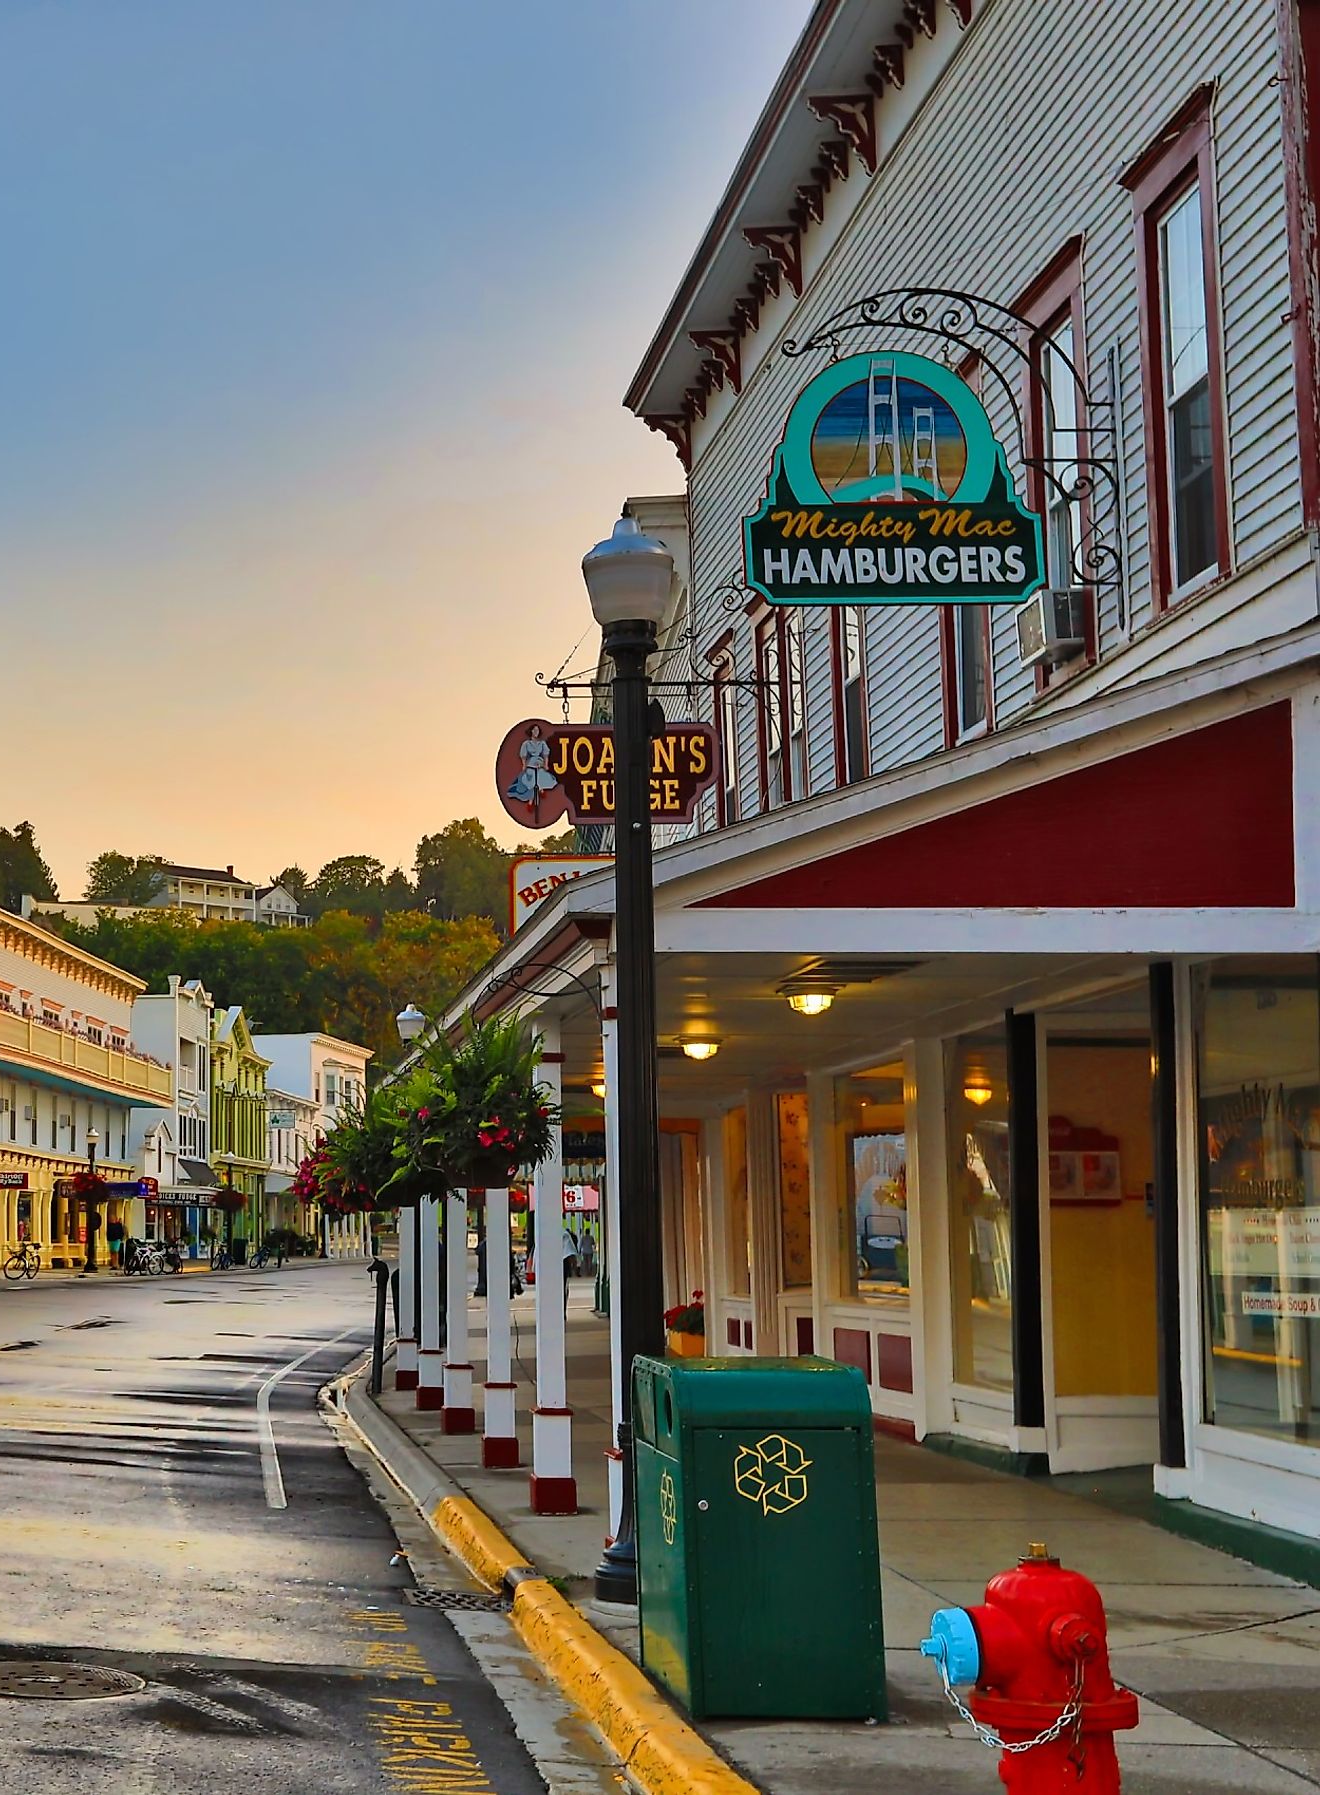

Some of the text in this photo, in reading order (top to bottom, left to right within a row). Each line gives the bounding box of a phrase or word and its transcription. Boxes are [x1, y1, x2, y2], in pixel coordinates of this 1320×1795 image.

[771, 508, 1017, 546] Mighty Mac
[763, 546, 1027, 585] HAMBURGERS
[553, 736, 707, 774] JOAN'S
[580, 779, 680, 811] FUGE
